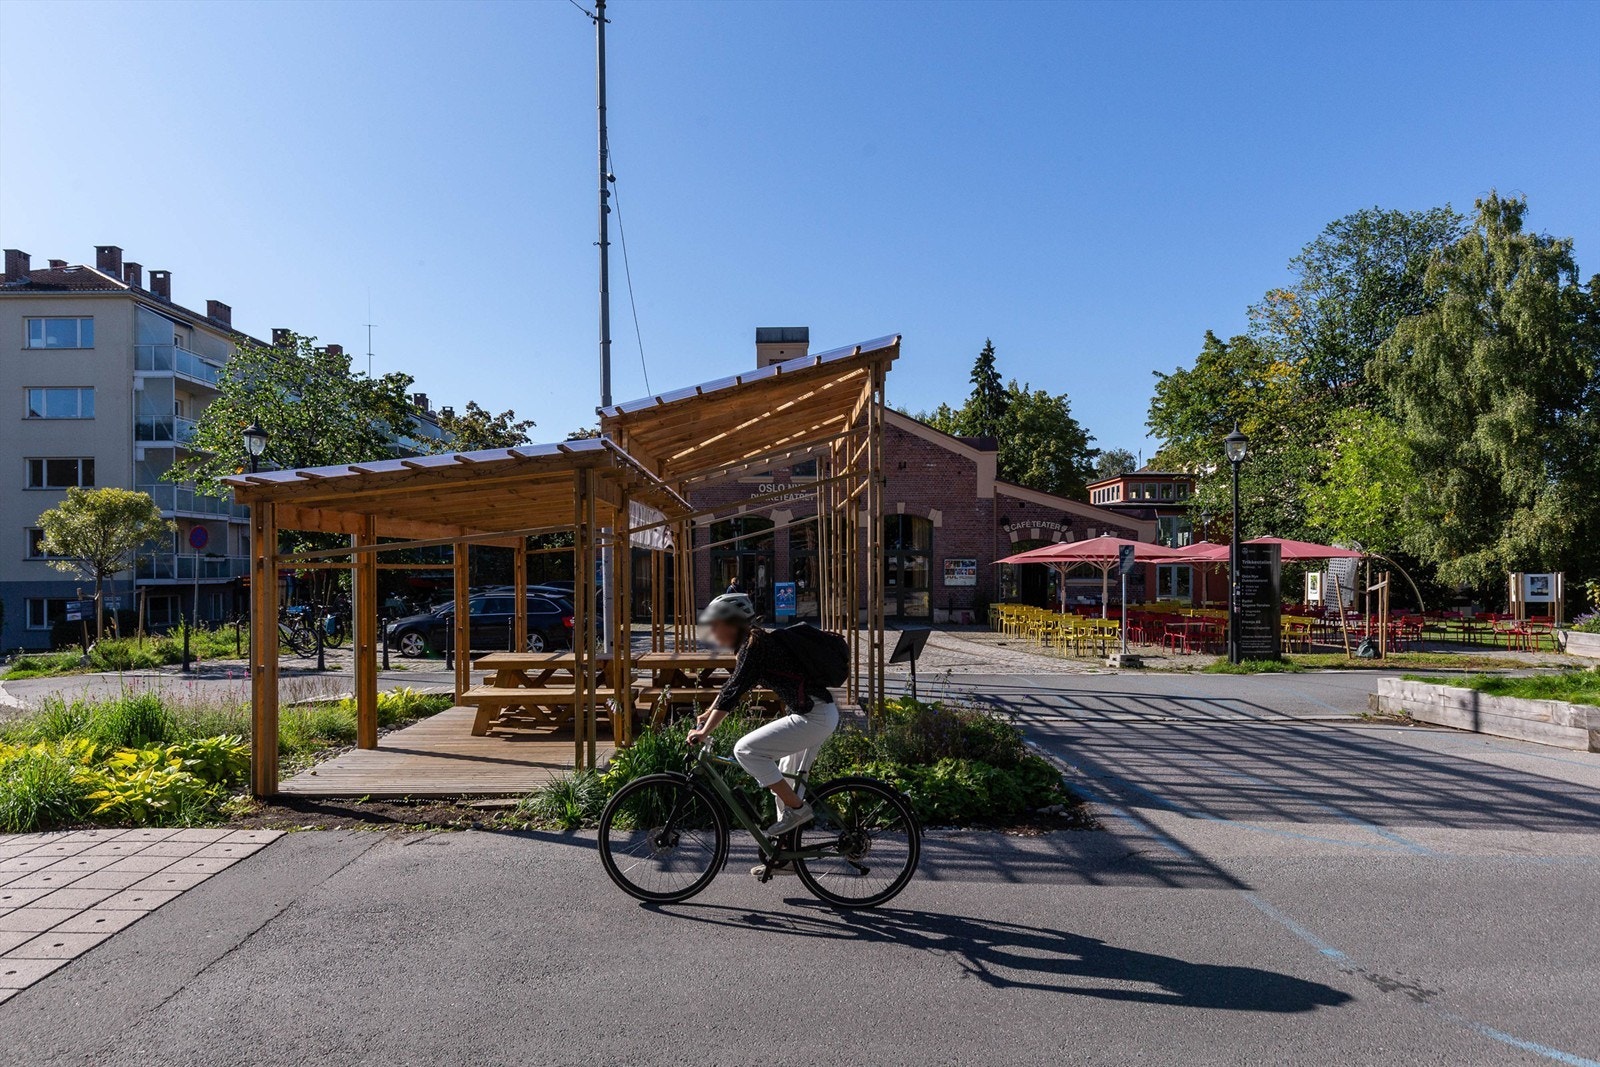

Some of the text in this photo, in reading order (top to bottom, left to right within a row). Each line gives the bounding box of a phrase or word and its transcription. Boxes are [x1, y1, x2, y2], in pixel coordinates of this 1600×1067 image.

[758, 484, 785, 493] OSLO
[1010, 520, 1060, 530] CAFÉ TEATER
